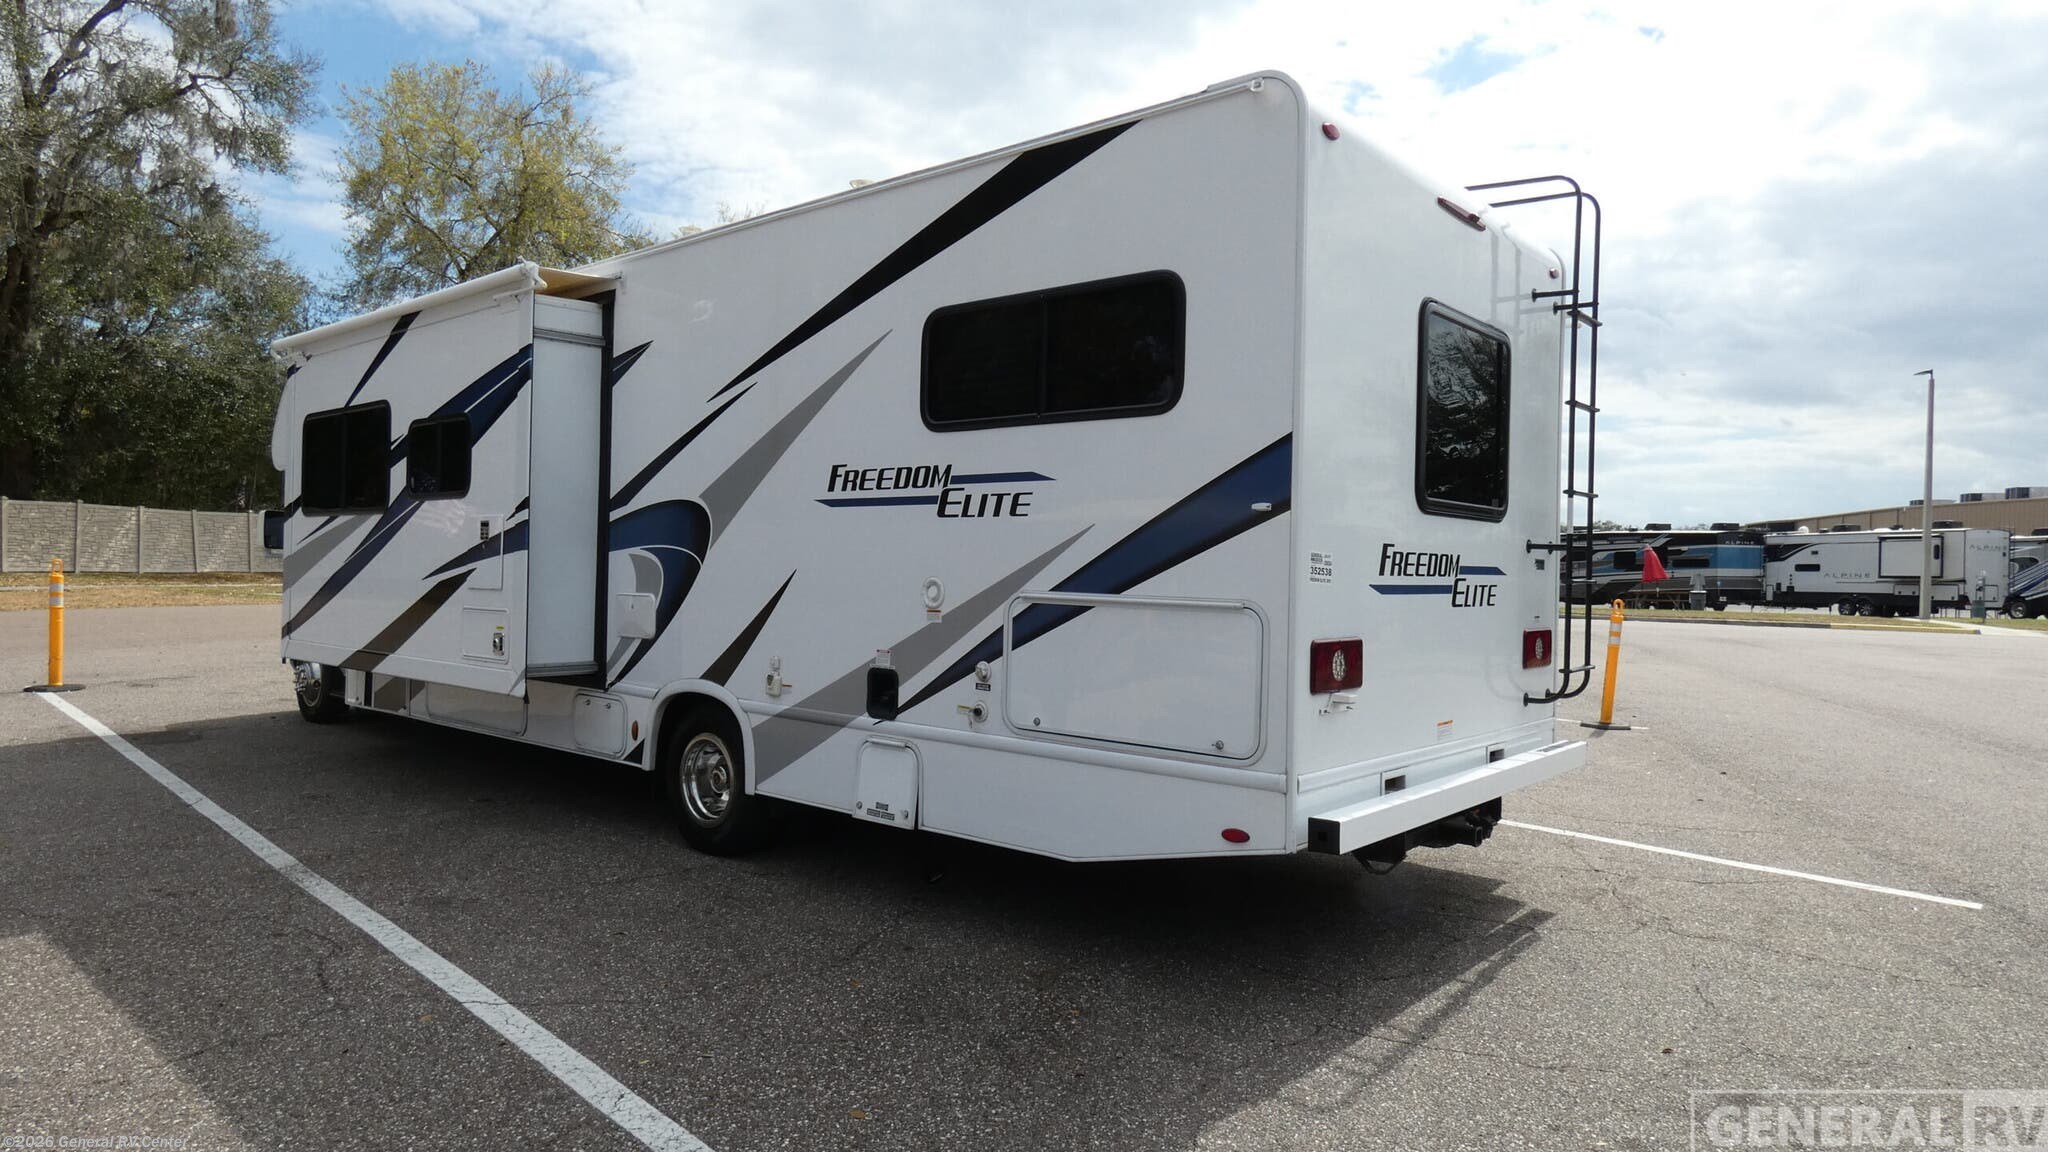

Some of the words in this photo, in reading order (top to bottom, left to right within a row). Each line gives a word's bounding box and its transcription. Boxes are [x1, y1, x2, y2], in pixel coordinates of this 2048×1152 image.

[827, 464, 952, 493] FREEDOM
[937, 487, 1033, 518] ELITE
[1378, 543, 1460, 578] FREEDOM
[1451, 578, 1498, 607] ELITE
